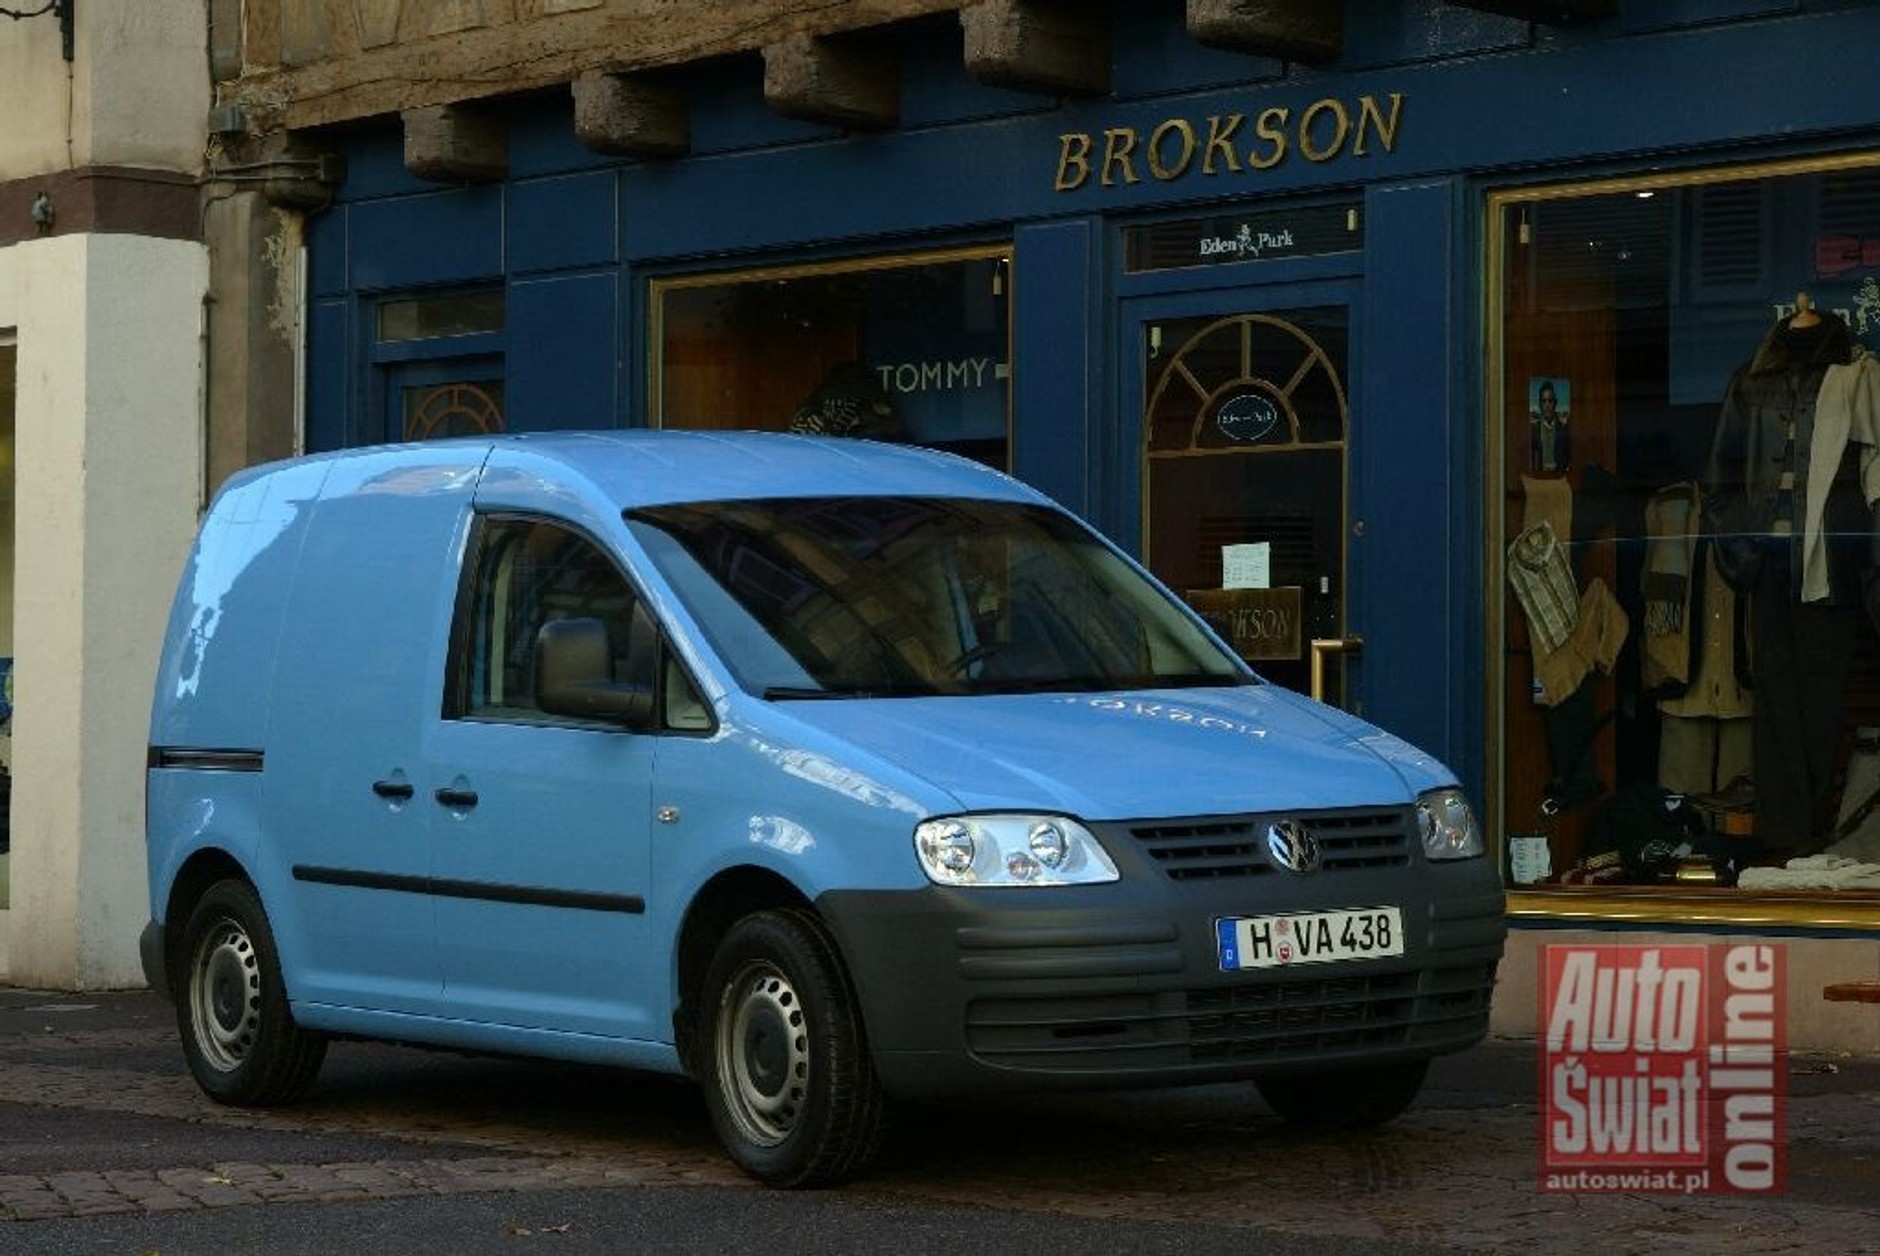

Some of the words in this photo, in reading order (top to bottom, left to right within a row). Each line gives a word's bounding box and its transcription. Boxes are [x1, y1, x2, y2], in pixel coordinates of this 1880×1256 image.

[1053, 93, 1403, 192] BROKSON
[1200, 236, 1237, 255] Eden
[1257, 229, 1294, 249] Park
[875, 357, 990, 393] TOMMY
[1250, 921, 1273, 960] H
[1293, 917, 1334, 957] VA
[1340, 913, 1391, 952] 438
[1225, 949, 1233, 961] D
